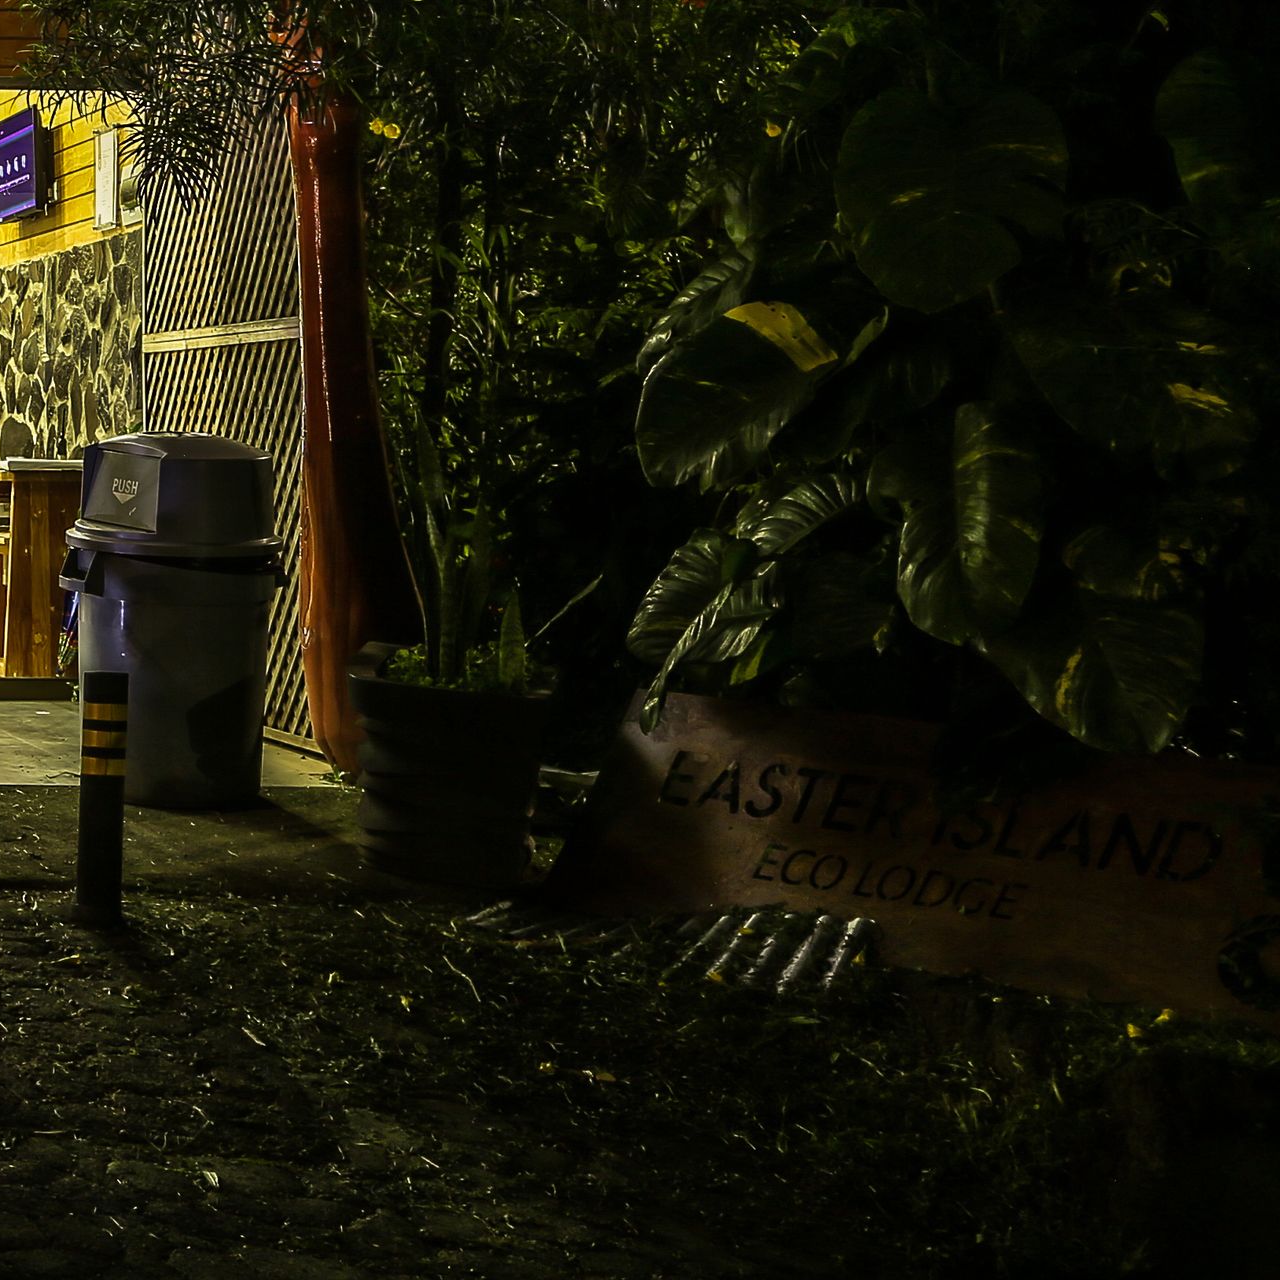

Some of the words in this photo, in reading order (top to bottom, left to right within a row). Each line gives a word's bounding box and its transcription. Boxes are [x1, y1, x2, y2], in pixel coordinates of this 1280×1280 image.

[112, 478, 138, 495] PUSH
[658, 750, 917, 839] EASTER
[930, 797, 1223, 882] ISLAND
[752, 843, 848, 891] ECO
[853, 863, 1030, 919] LODGE
